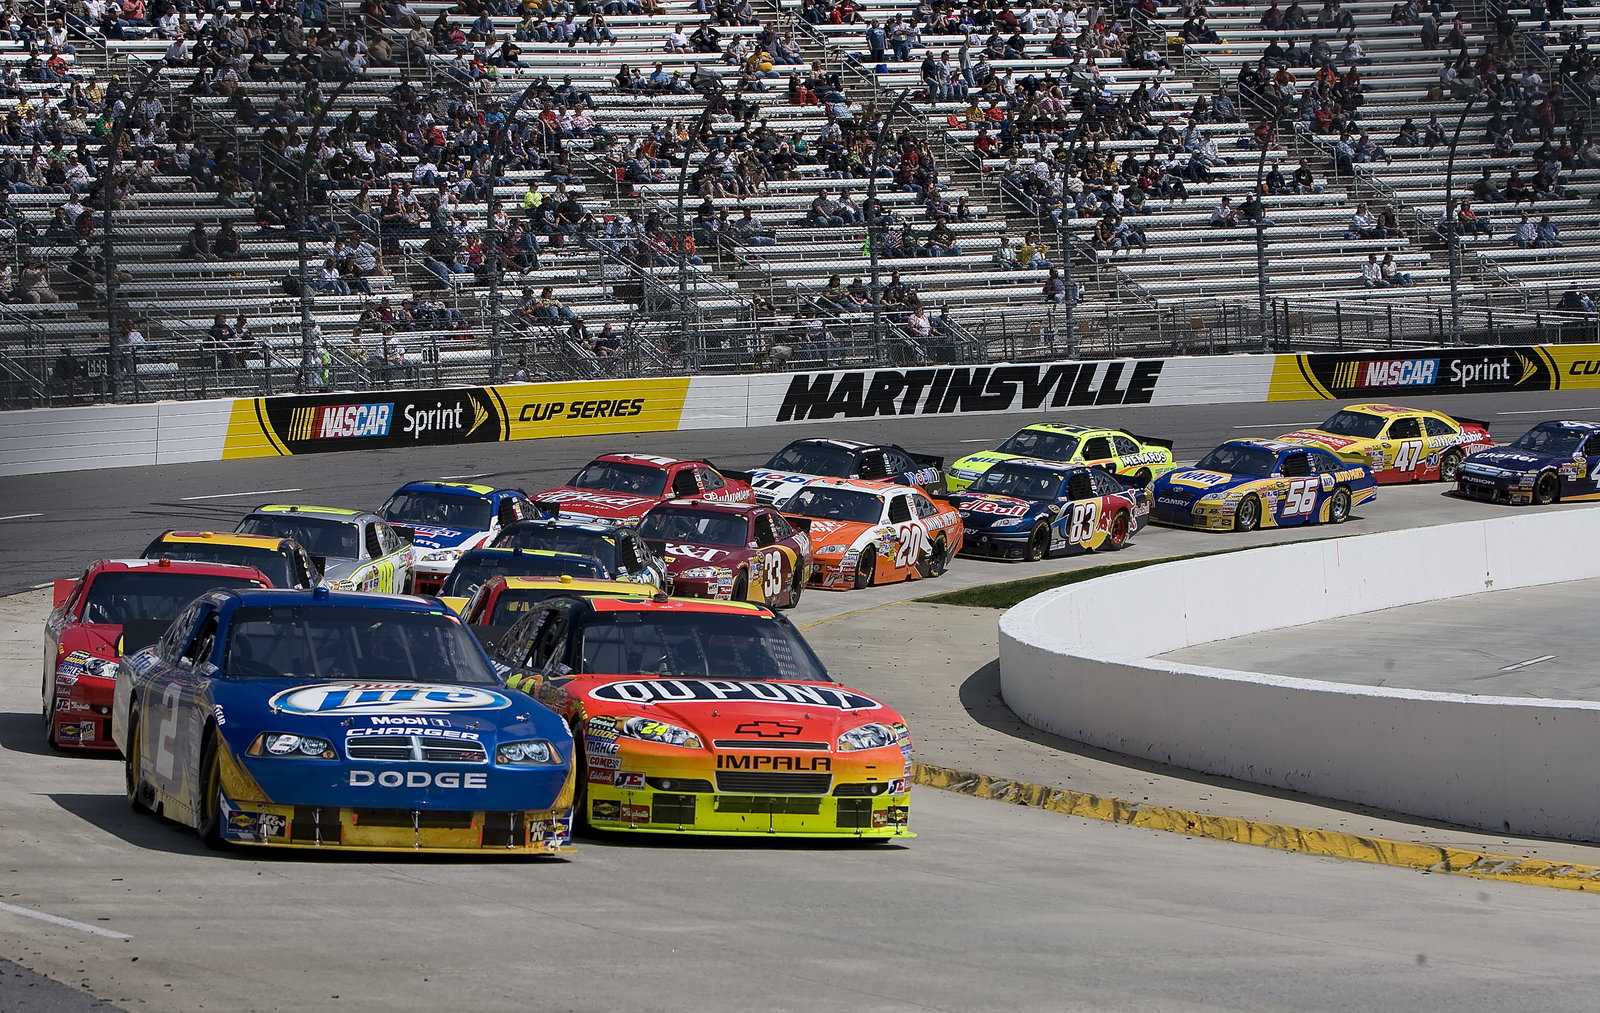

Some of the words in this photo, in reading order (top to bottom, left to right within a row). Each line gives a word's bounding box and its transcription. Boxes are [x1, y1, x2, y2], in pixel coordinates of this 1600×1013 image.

[1365, 360, 1435, 386] NASCAR
[1450, 358, 1510, 387] Sprint
[1569, 360, 1600, 375] CU
[776, 361, 1164, 422] MARTINSVILLE
[519, 402, 565, 422] CUP
[566, 399, 645, 419] SERIES
[319, 405, 390, 437] NASCAR
[403, 402, 463, 439] Sprint
[1120, 452, 1167, 467] MENARDS
[1394, 440, 1424, 472] 47
[1475, 452, 1539, 462] Charter
[1177, 471, 1225, 484] NAPA
[1462, 475, 1496, 486] FUSION
[1158, 497, 1190, 507] CAMRY
[1283, 479, 1319, 515] 56
[1070, 502, 1097, 544] 83
[895, 523, 923, 568] 20
[764, 551, 782, 597] 33
[370, 716, 429, 725] Mobil
[641, 722, 670, 736] 24
[155, 682, 183, 781] 2
[346, 727, 480, 741] CHARGER
[586, 728, 618, 740] MOOG
[587, 741, 618, 755] MAHLE
[717, 754, 831, 771] IMPALA
[350, 770, 488, 789] DODGE
[615, 773, 643, 787] JE
[888, 779, 904, 795] JE
